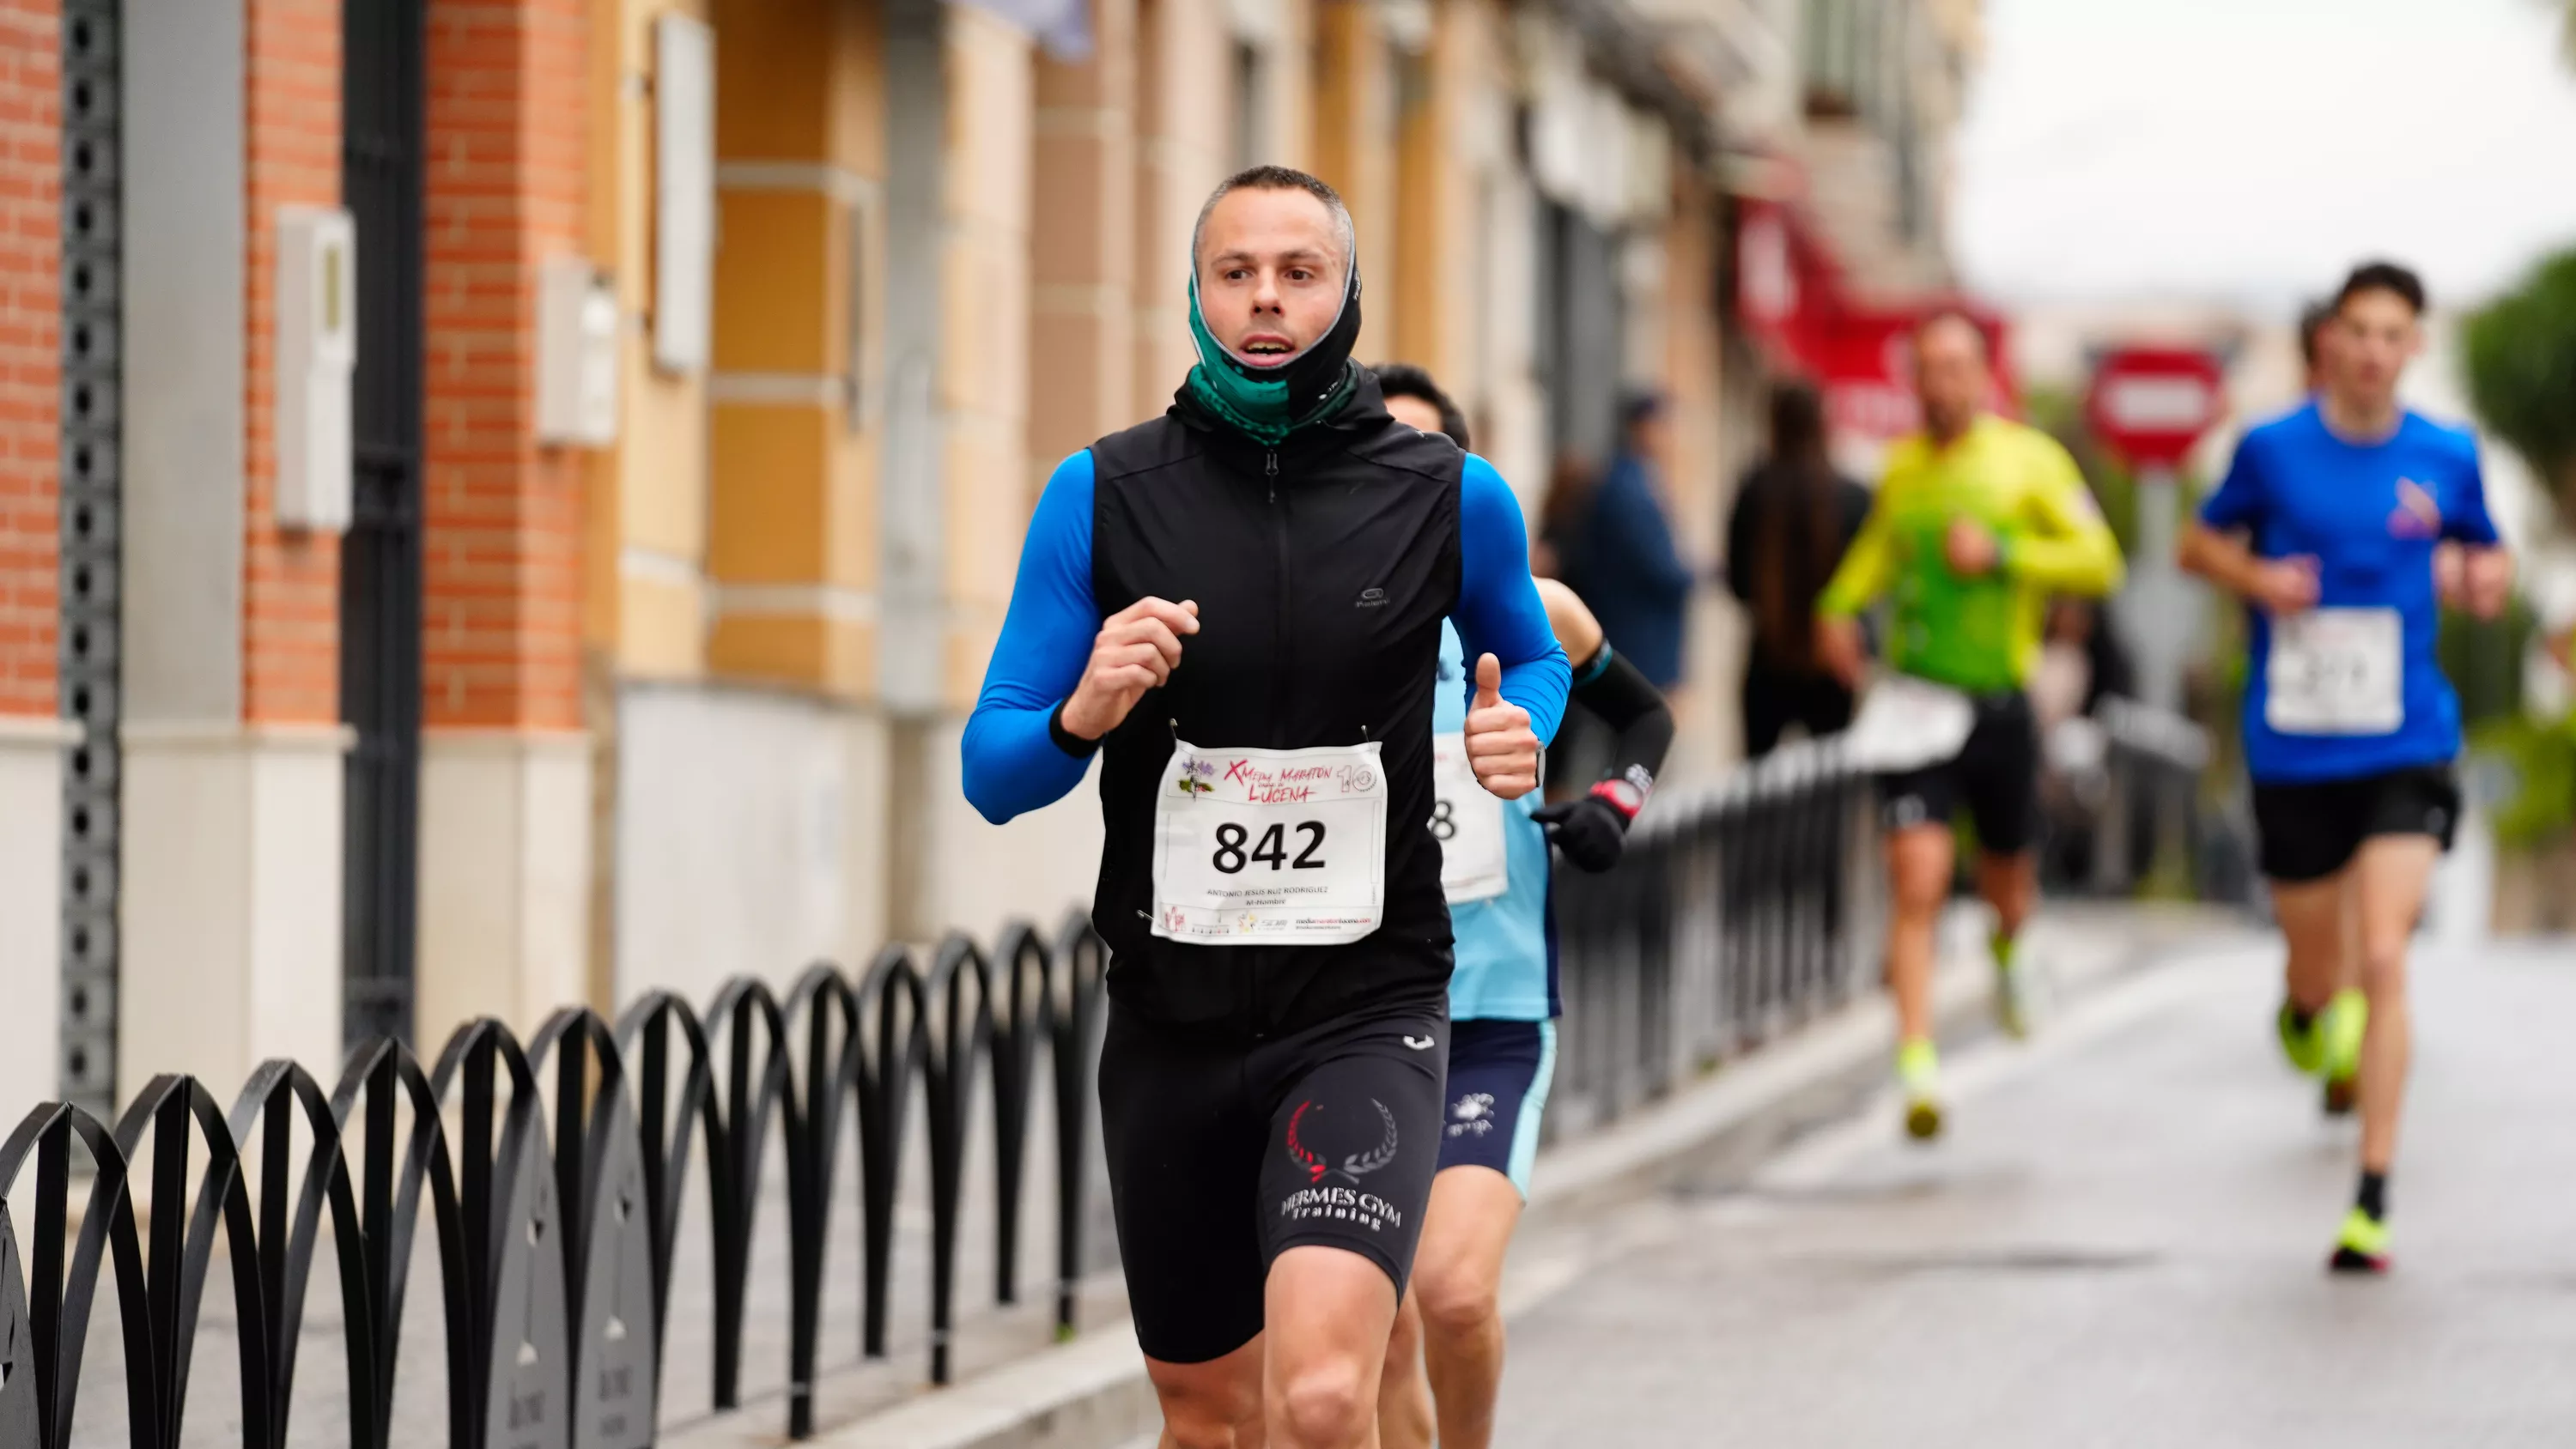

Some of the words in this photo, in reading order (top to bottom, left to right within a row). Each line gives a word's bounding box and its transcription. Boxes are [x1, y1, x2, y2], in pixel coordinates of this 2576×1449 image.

[1224, 759, 1248, 786] X
[1249, 783, 1318, 803] LUCENA
[1212, 820, 1327, 874] 842
[1207, 888, 1242, 898] ANTONIO
[1284, 886, 1328, 894] RODRIGUEZ
[1280, 1186, 1357, 1216] HERMES
[1358, 1193, 1401, 1228] GYM
[1291, 1203, 1382, 1232] Training
